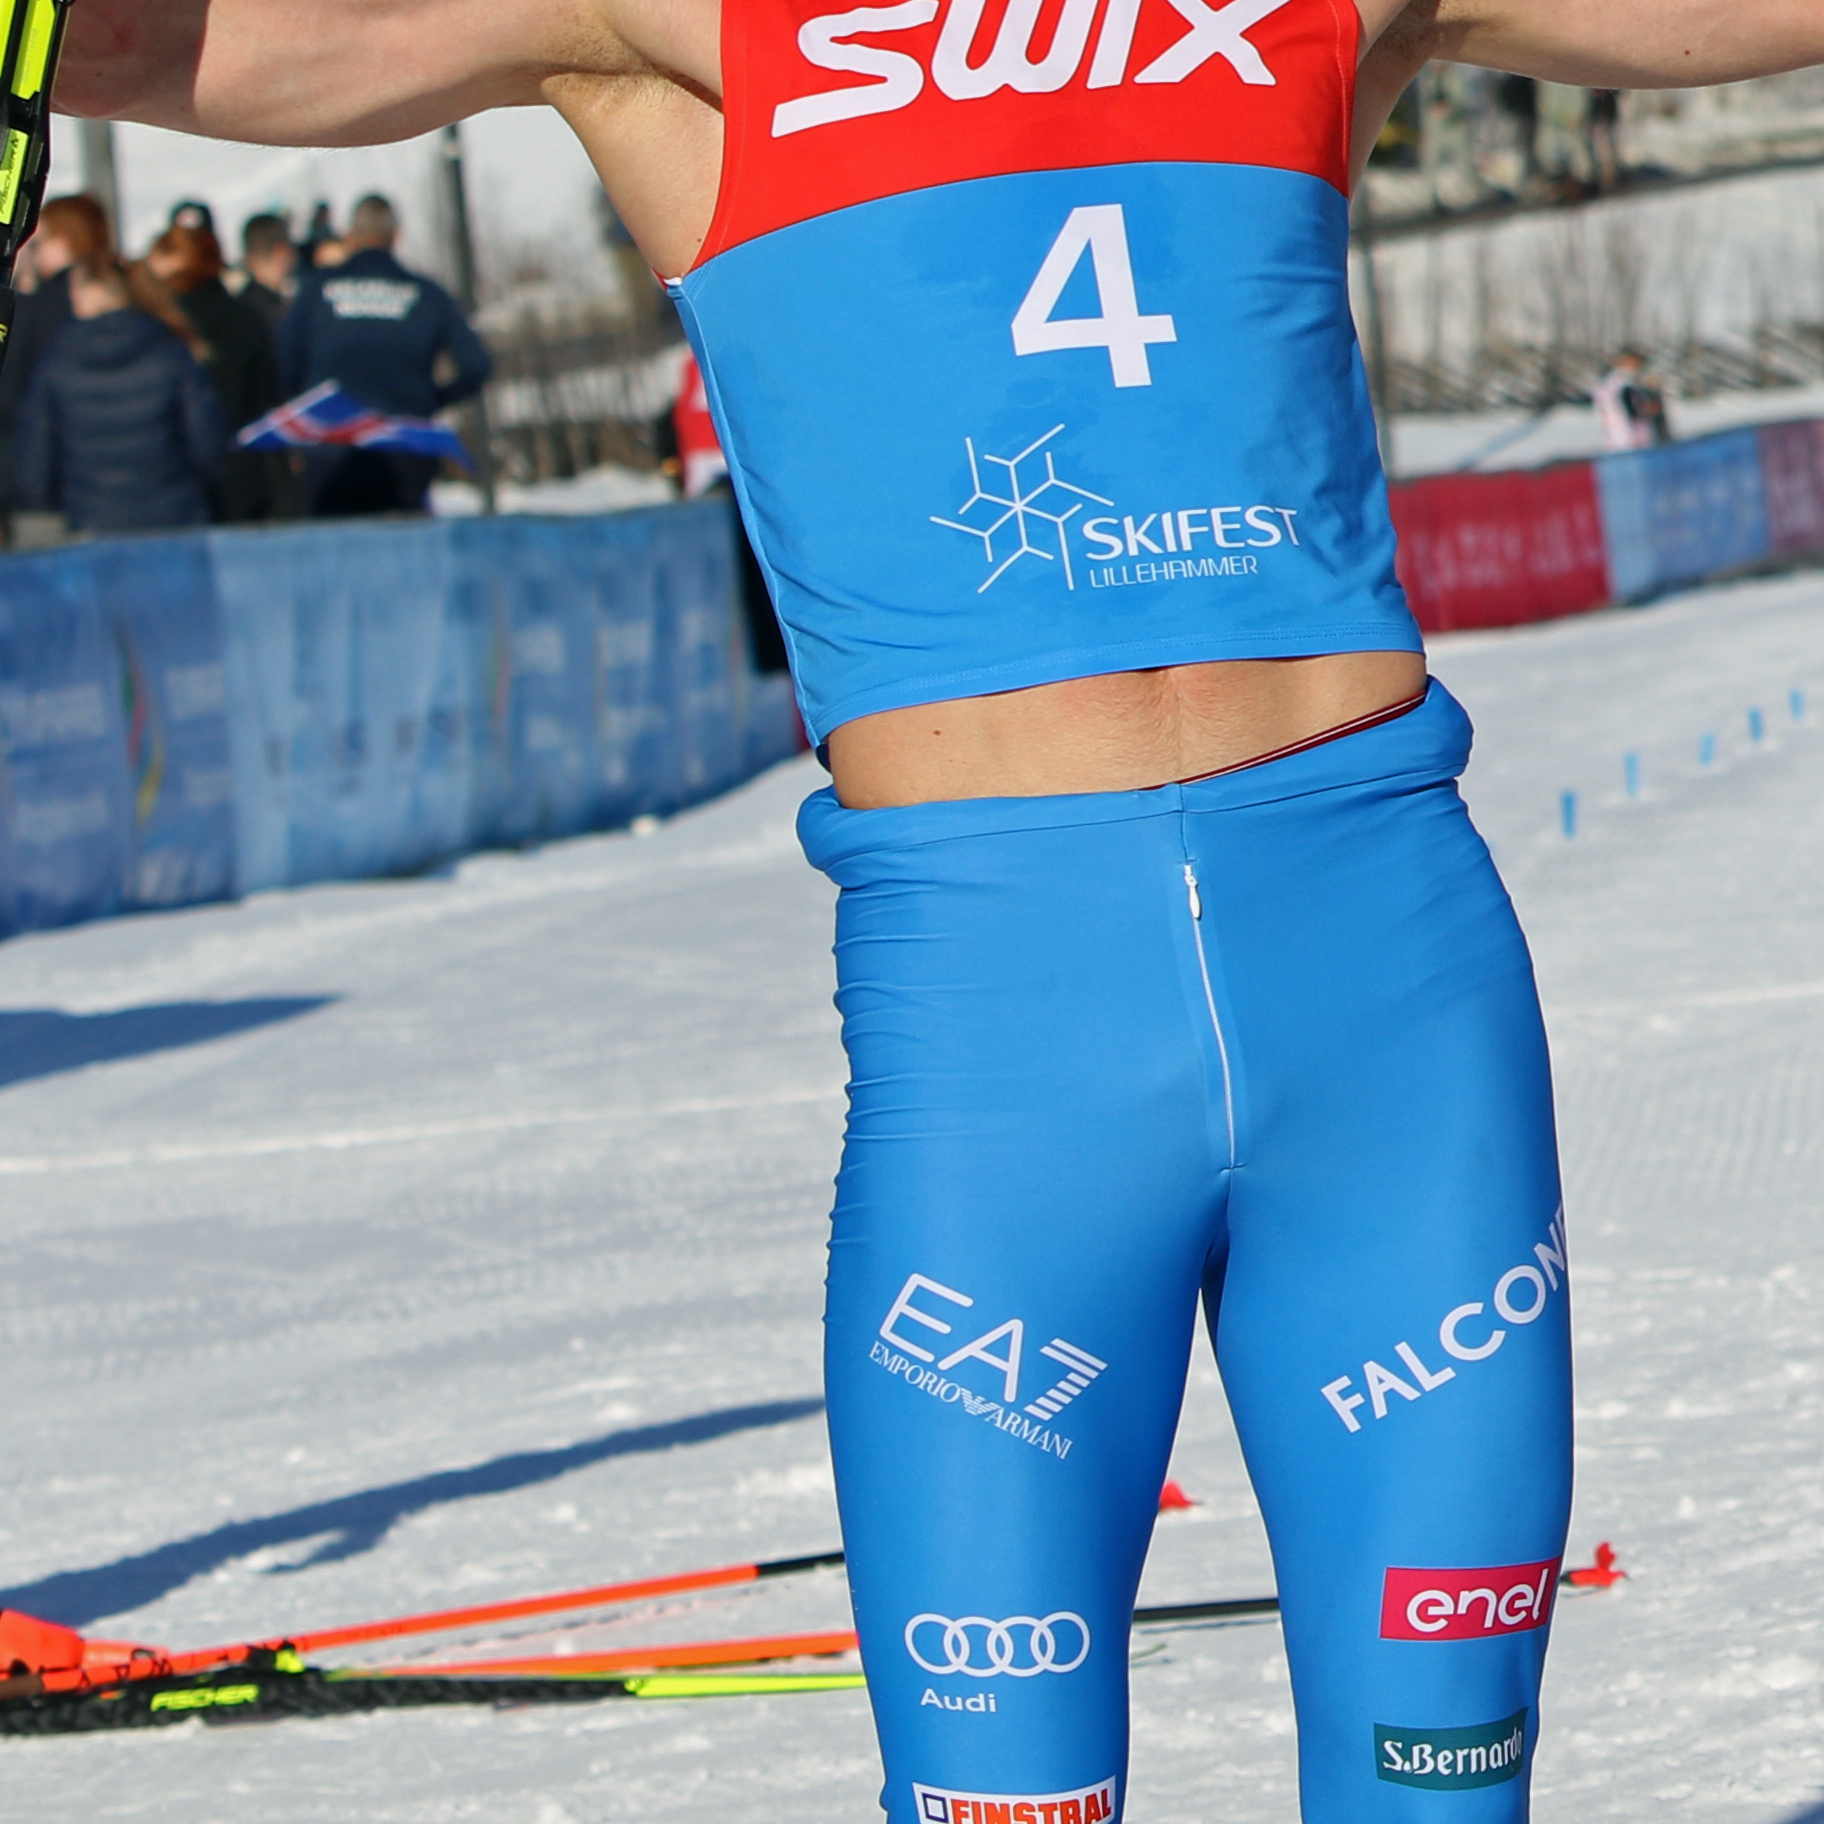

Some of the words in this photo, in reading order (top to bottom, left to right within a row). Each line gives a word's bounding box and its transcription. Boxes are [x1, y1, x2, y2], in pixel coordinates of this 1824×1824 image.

[1010, 202, 1178, 389] 4
[1081, 504, 1301, 561] SKIFEST
[1089, 553, 1260, 589] LILLEHAMMER
[868, 1340, 962, 1408] EMPORIO
[984, 1402, 1073, 1460] ARMANI
[1404, 1567, 1551, 1633] enel
[919, 1687, 998, 1715] Audi
[1382, 1726, 1522, 1776] S.Bernardo
[950, 1788, 1113, 1824] FINSTRAL
